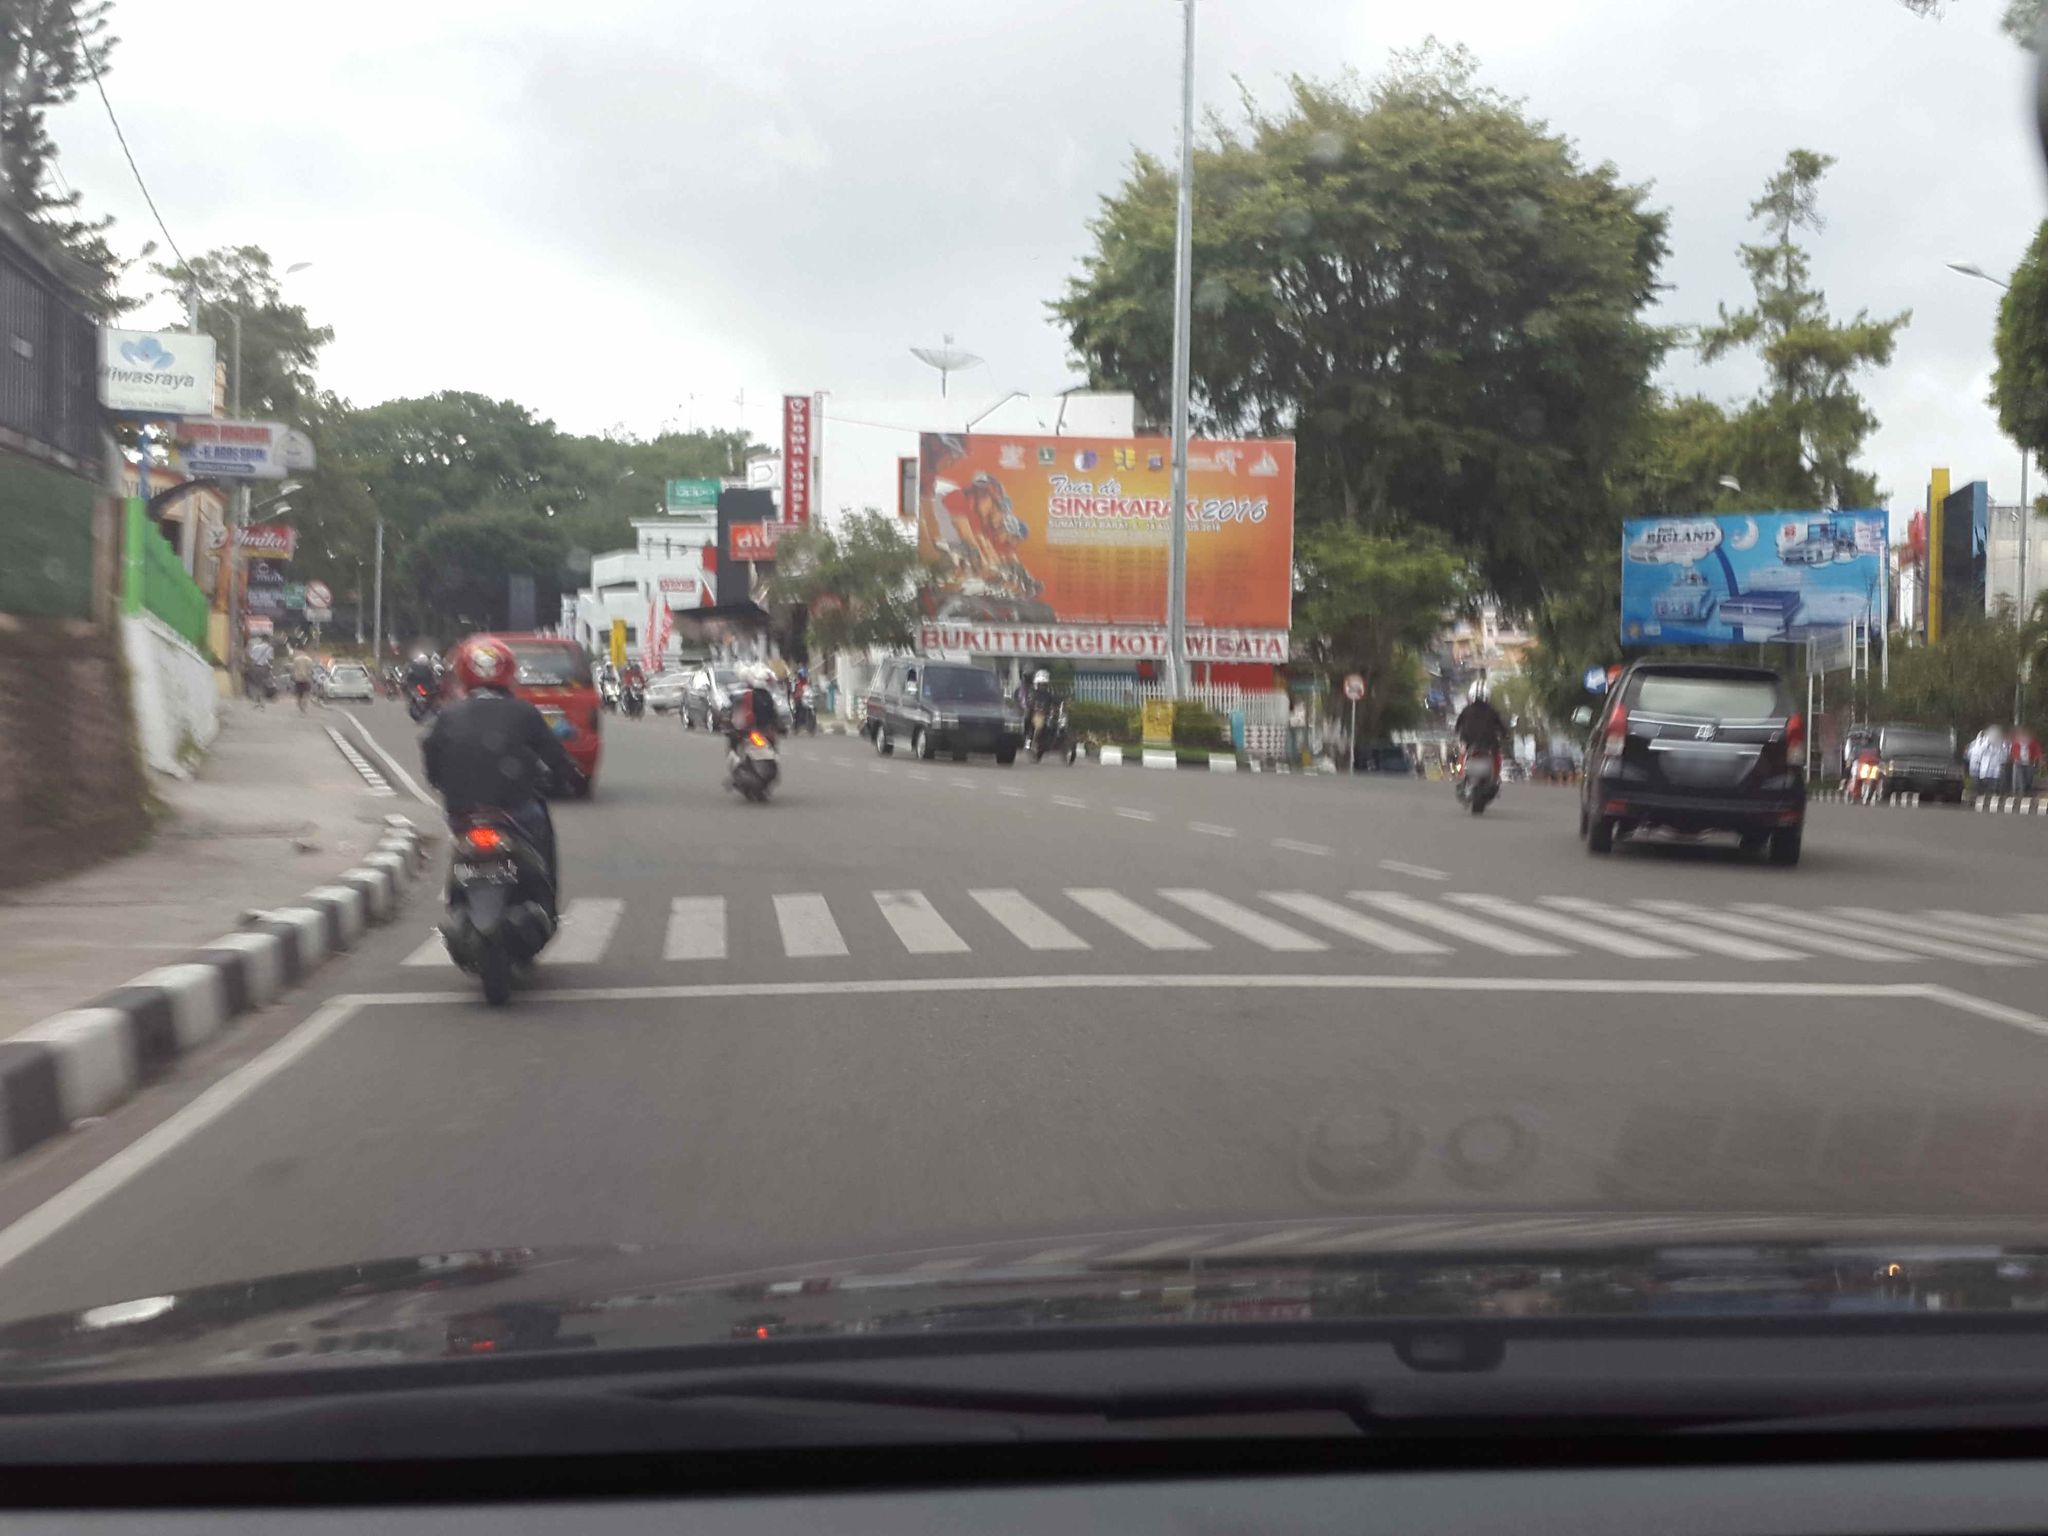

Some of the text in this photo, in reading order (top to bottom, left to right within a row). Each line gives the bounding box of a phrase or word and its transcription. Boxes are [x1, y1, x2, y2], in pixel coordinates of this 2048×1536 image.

[1050, 475, 1120, 495] Tour de
[1202, 498, 1267, 522] 2016
[921, 629, 1103, 653] BUKITTINGGI
[1186, 635, 1284, 660] WISATA
